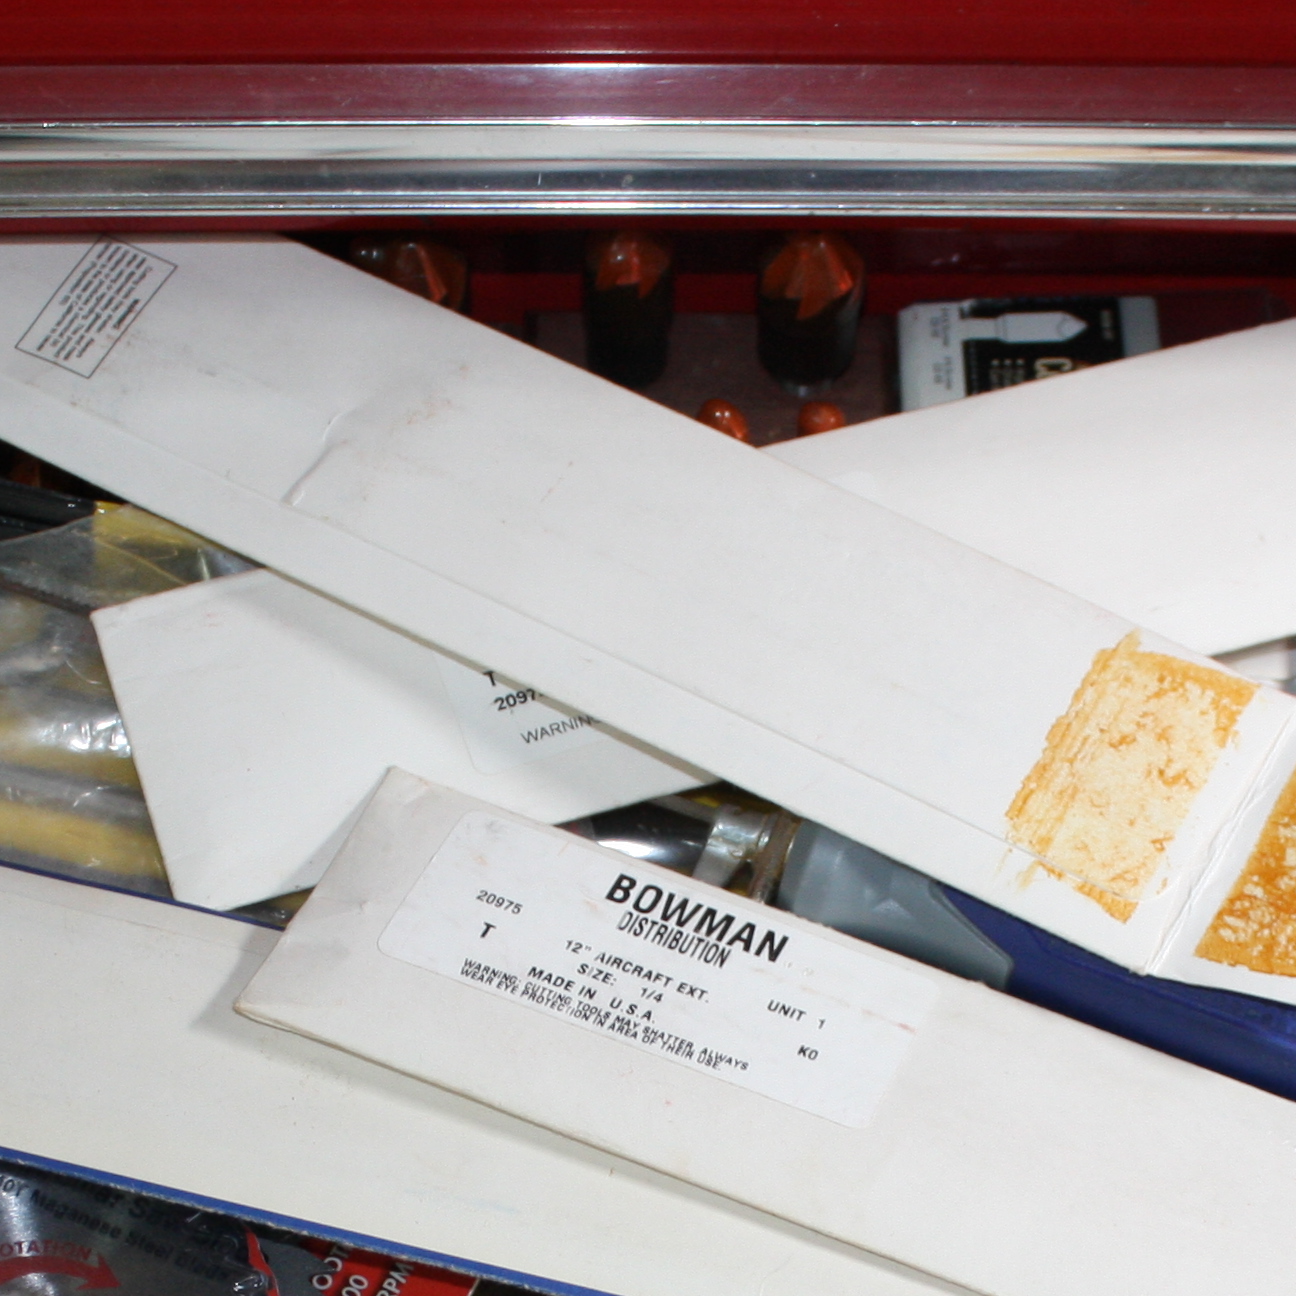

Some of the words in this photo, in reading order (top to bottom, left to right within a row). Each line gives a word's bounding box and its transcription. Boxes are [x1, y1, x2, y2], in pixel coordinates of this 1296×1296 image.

[493, 686, 542, 711] 2097
[521, 713, 593, 744] WARNIN
[475, 888, 522, 915] 20975
[604, 870, 789, 963] BOWMAN
[478, 921, 496, 940] T
[616, 909, 731, 969] DISTRIBUTION
[563, 938, 591, 958] 12"
[594, 950, 672, 988] AIRCRAFT
[675, 981, 711, 1003] EXT.
[576, 962, 617, 986] SIZE:
[638, 985, 664, 1004] 1/4
[496, 979, 518, 995] EYE
[519, 987, 591, 1023] PROTECTION
[606, 1020, 639, 1040] AREA
[526, 965, 575, 993] MADE
[577, 984, 596, 1000] IN
[608, 996, 657, 1023] U.S.A.
[765, 998, 806, 1023] UNIT
